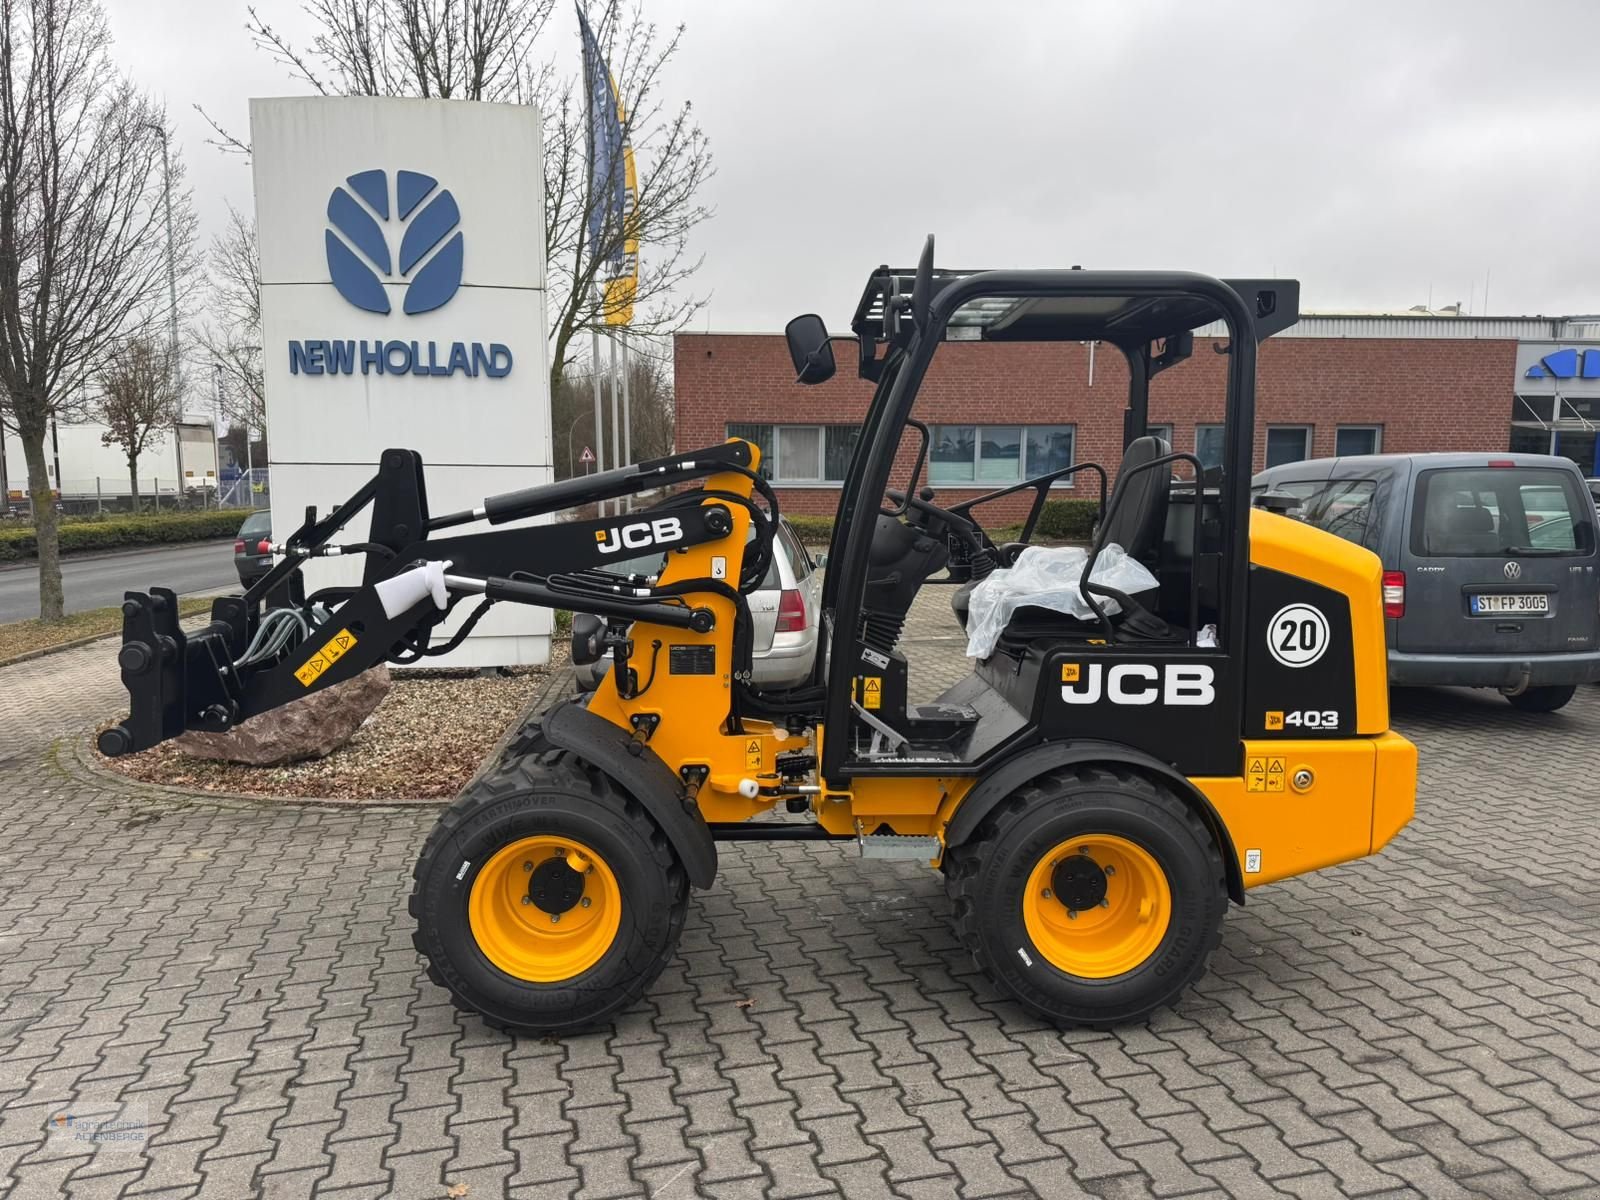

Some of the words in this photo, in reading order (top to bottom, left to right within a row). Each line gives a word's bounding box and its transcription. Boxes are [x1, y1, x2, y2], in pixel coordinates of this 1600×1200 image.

[288, 340, 356, 375] NEW
[359, 340, 513, 377] HOLLAND
[596, 517, 684, 554] JCB
[1479, 596, 1492, 610] ST
[1501, 596, 1516, 610] FP
[1518, 596, 1547, 610] 3005
[1279, 619, 1317, 652] 20
[1061, 663, 1216, 706] JCB
[1285, 710, 1339, 727] 403
[1154, 926, 1193, 977] GUARD
